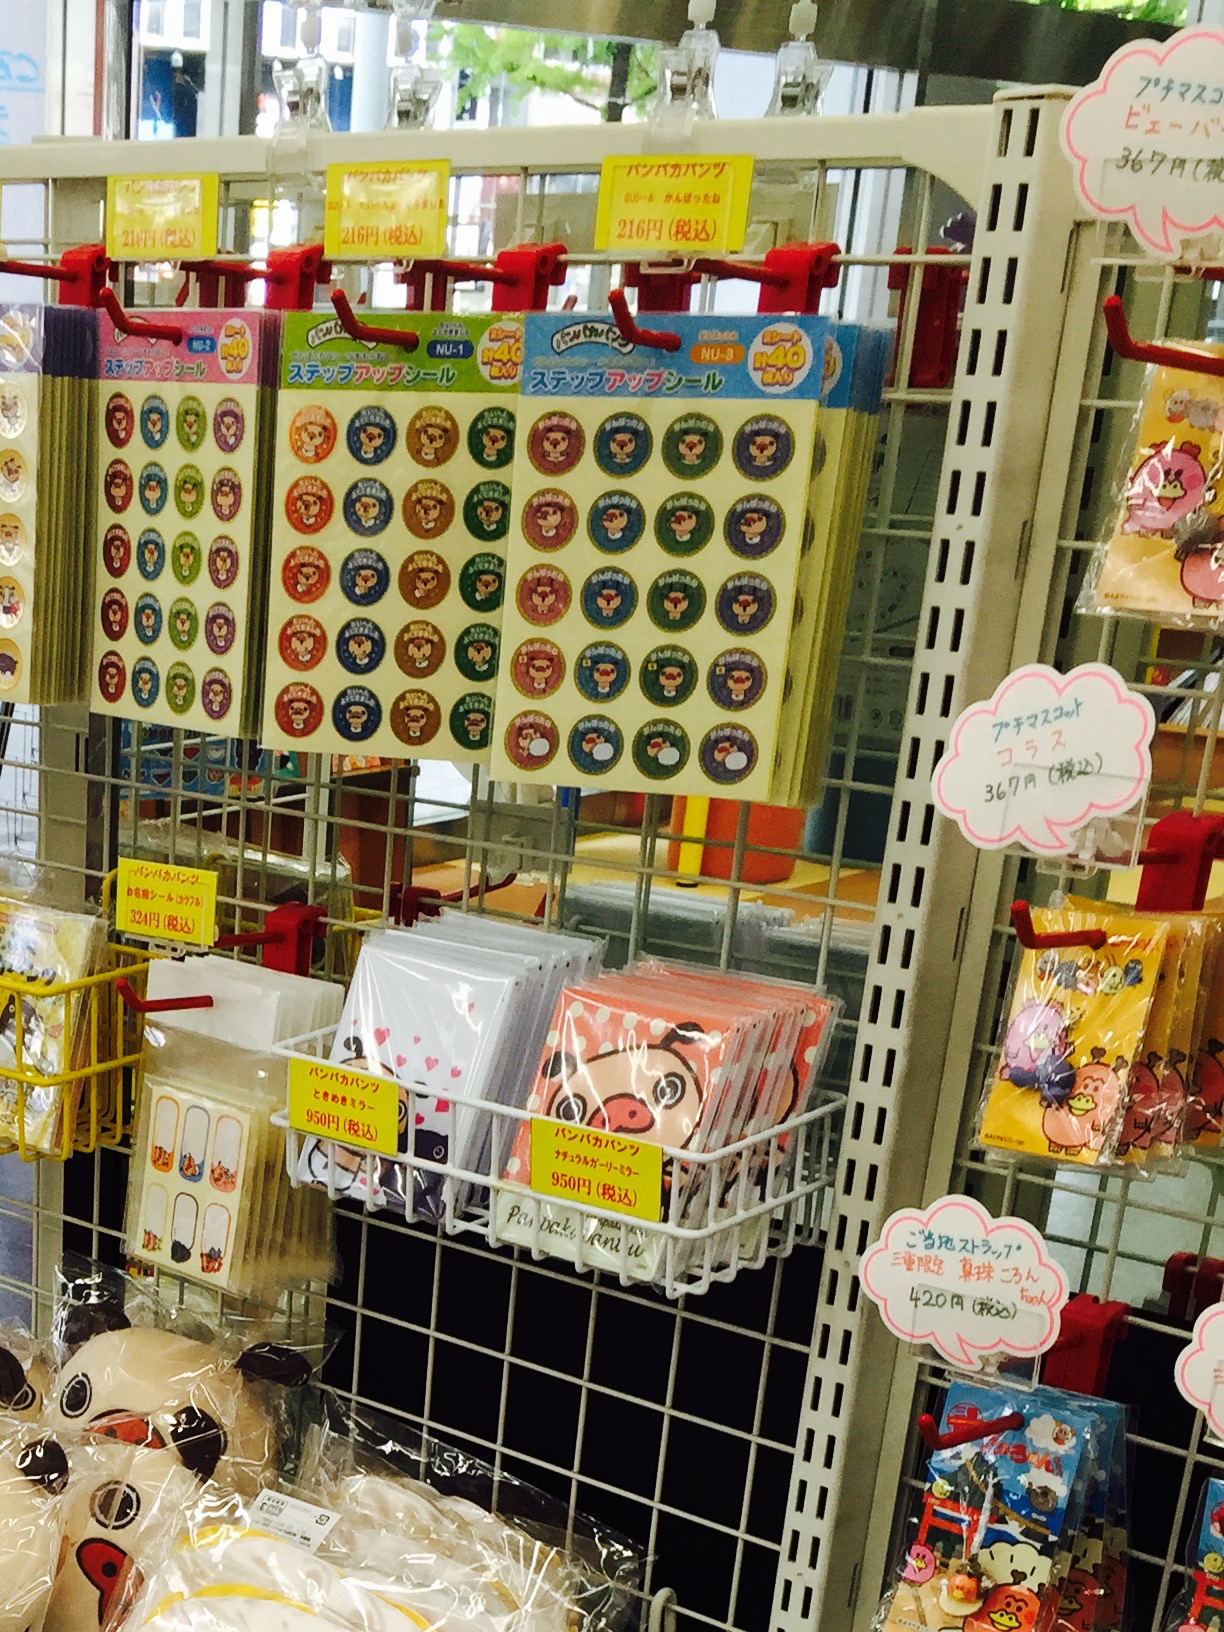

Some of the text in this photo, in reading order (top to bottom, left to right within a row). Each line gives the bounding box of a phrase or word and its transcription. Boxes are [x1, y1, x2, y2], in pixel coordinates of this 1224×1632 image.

[436, 344, 464, 356] NU-1
[701, 347, 734, 361] NU-3
[288, 363, 457, 385] ステップアップシール
[531, 369, 724, 393] ステップアップシール
[309, 1067, 380, 1094] パンパカパンツ
[554, 1127, 640, 1157] パンパカパンツ
[554, 1149, 640, 1178] ナチュラルガーリーミラー
